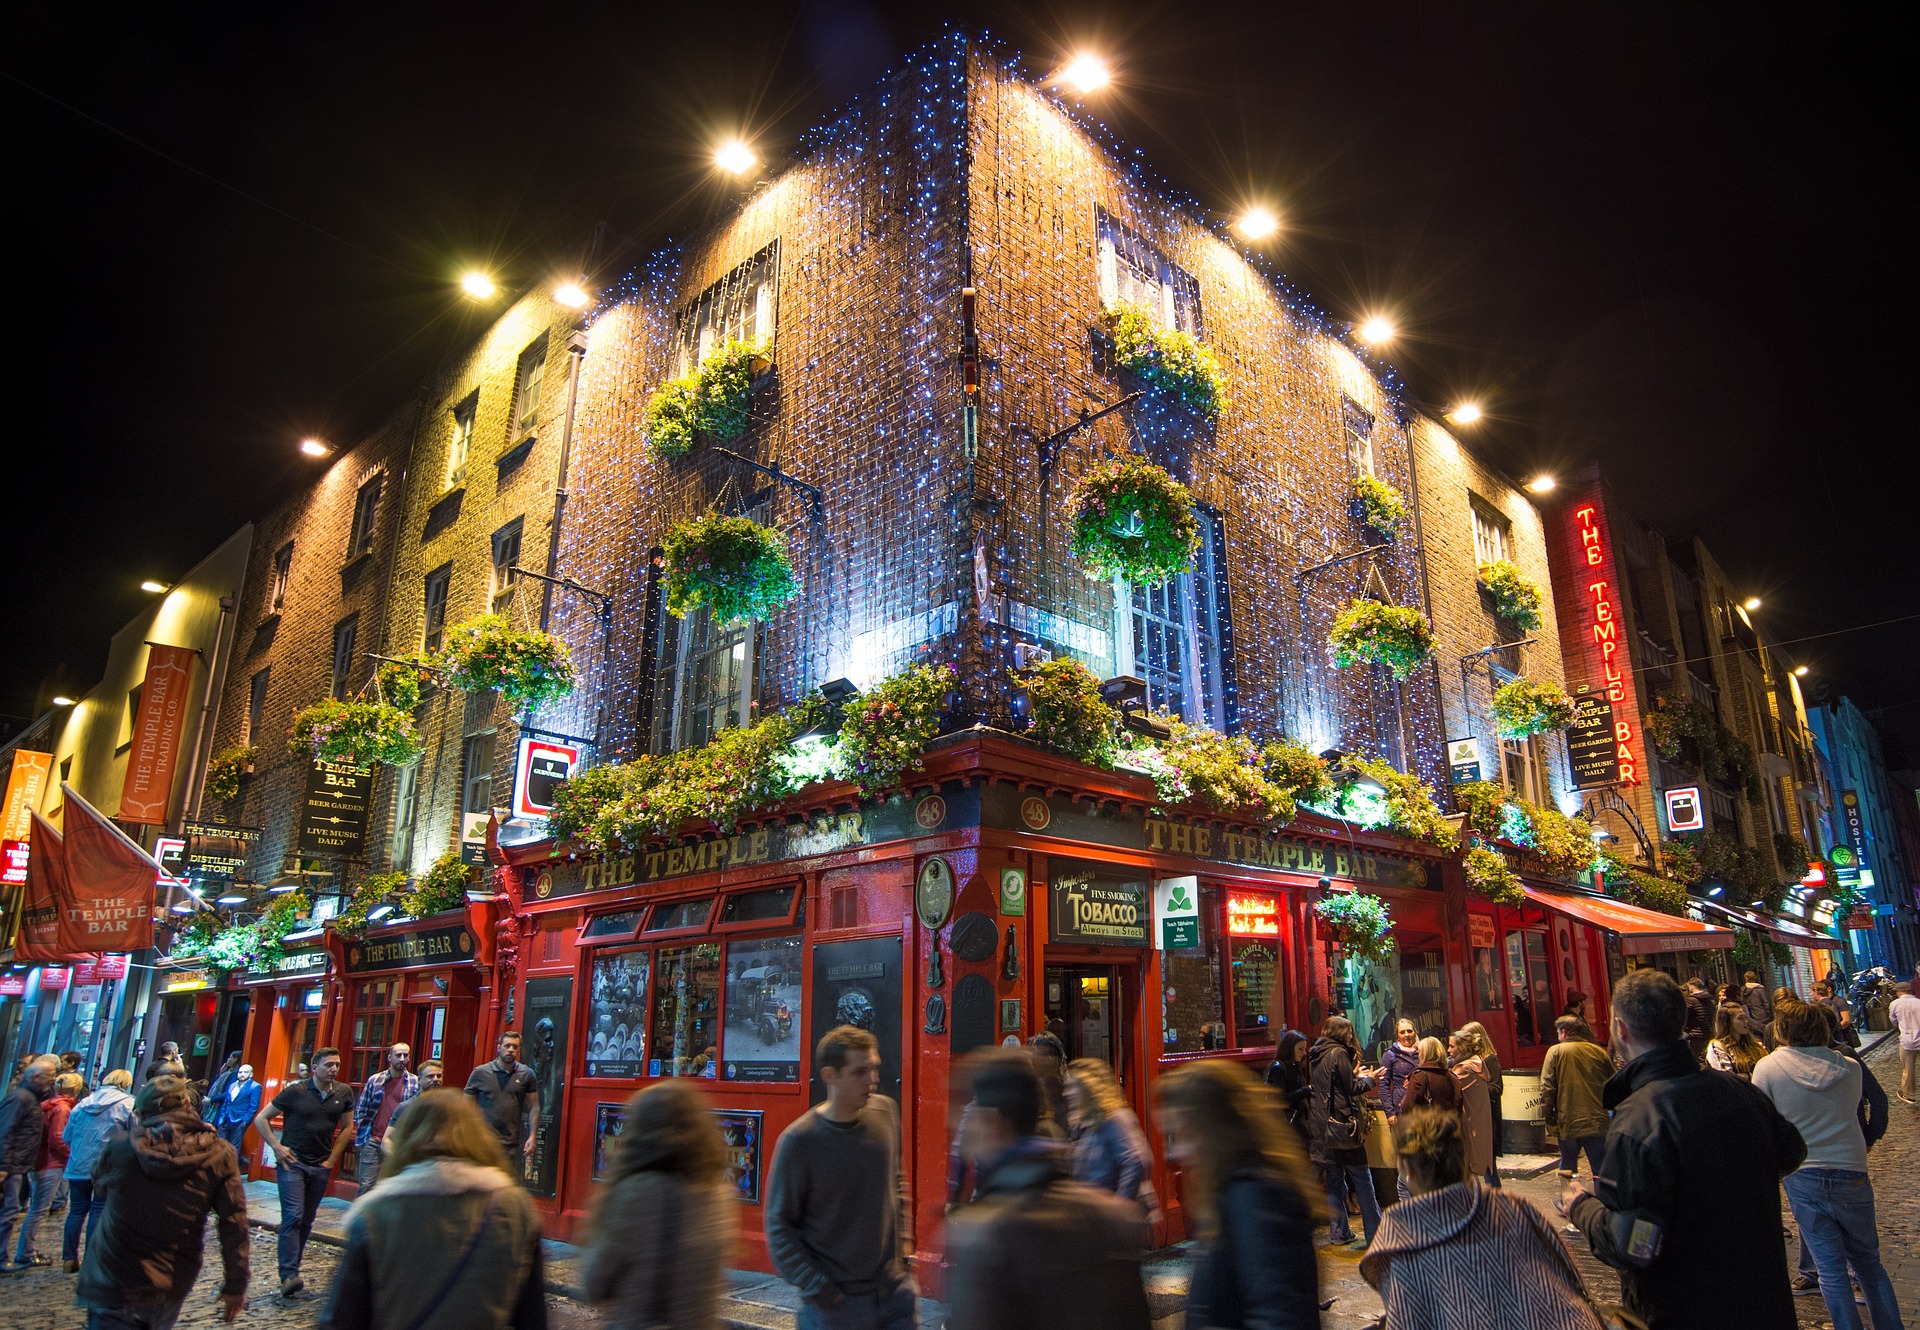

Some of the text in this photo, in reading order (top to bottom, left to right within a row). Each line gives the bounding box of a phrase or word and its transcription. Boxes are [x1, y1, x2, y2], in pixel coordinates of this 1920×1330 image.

[1577, 507, 1637, 783] THE TEMPLE BAR
[1578, 700, 1595, 708] THE
[1577, 717, 1602, 729] BAR
[134, 676, 169, 793] THE TEMPLE BAR
[155, 698, 179, 775] TRADING CO.
[1587, 737, 1613, 746] GARDEN
[1574, 759, 1615, 771] LIVE MUSIC
[533, 768, 565, 779] GUINNESS
[1584, 768, 1606, 777] DAILY
[25, 774, 40, 794] THE
[324, 773, 357, 788] BAR
[308, 799, 365, 812] BEER GARDEN
[920, 801, 940, 823] 48
[1025, 801, 1044, 822] 48
[186, 825, 260, 841] THE TEMPLE BAR
[307, 827, 359, 839] LIVE MUSIC
[1847, 808, 1865, 866] HOSTEL
[317, 837, 346, 846] DAILY
[1145, 818, 1379, 881] THE TEMPLE BAR
[189, 854, 248, 867] DISTILLERY
[582, 858, 636, 890] THE
[645, 831, 769, 879] TEMPLE
[201, 864, 234, 874] STORE
[1054, 869, 1096, 893] Importers
[1080, 883, 1089, 891] OF
[1091, 889, 1137, 902] FINE SMOKING
[91, 898, 126, 909] THE
[67, 905, 148, 922] TEMPLE
[1066, 892, 1137, 930] TOBACCO
[25, 913, 57, 926] TEMP
[34, 925, 56, 934] IRISH
[87, 920, 128, 934] BAR
[1081, 925, 1143, 937] Always in Stock
[365, 935, 452, 963] THE TEMPLE BAR
[1239, 943, 1274, 962] TEMPLE BAR
[1423, 951, 1438, 969] THE
[1408, 970, 1440, 988] EMPEROR
